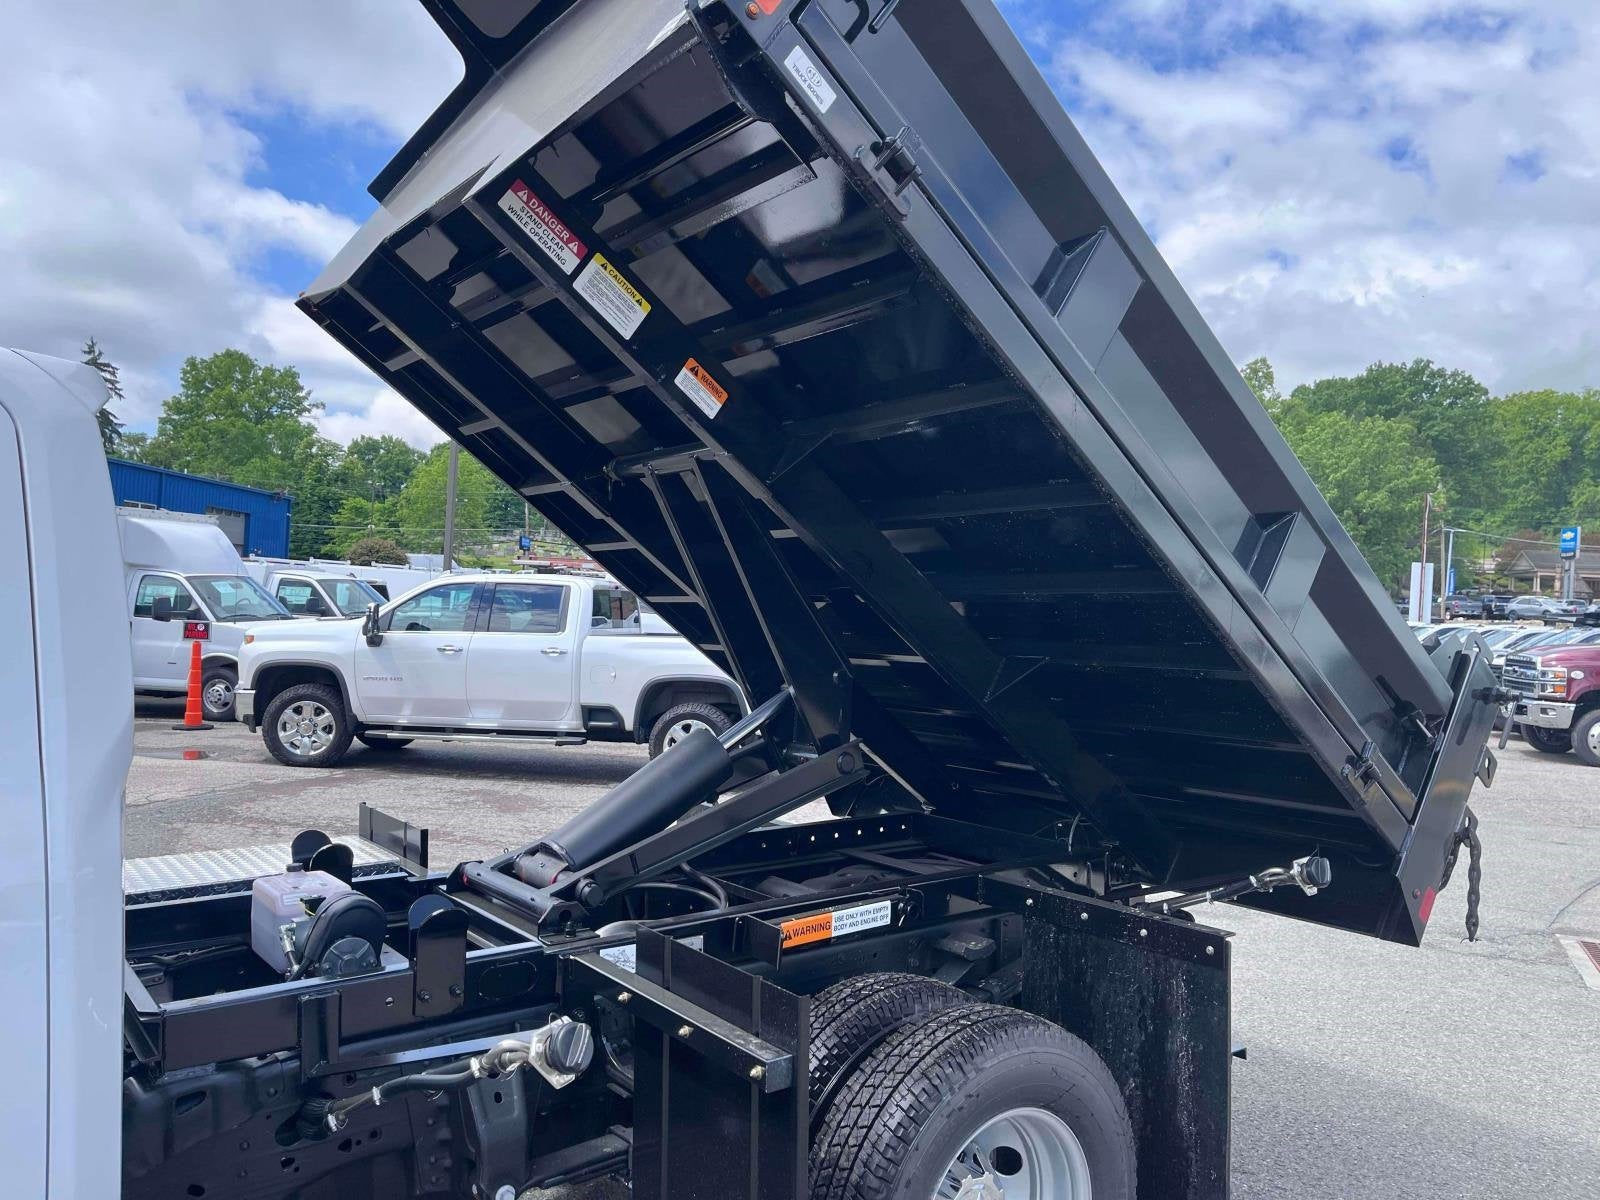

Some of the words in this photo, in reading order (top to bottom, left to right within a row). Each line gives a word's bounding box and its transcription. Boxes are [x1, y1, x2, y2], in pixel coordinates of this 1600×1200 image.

[792, 63, 809, 84] TRUCK
[520, 206, 543, 229] STAND
[542, 229, 565, 252] CLEAR
[529, 198, 570, 242] DANGER
[507, 204, 529, 229] WHILE
[529, 227, 567, 266] OPERATING
[608, 269, 637, 299] CAUTION
[701, 373, 724, 398] WARNING
[834, 915, 844, 923] USE
[845, 912, 858, 921] ONLY
[860, 909, 872, 917] WITH
[872, 905, 889, 915] EMPTY
[849, 920, 860, 928] AND
[860, 916, 879, 925] ENGINE
[792, 921, 831, 937] WARNING
